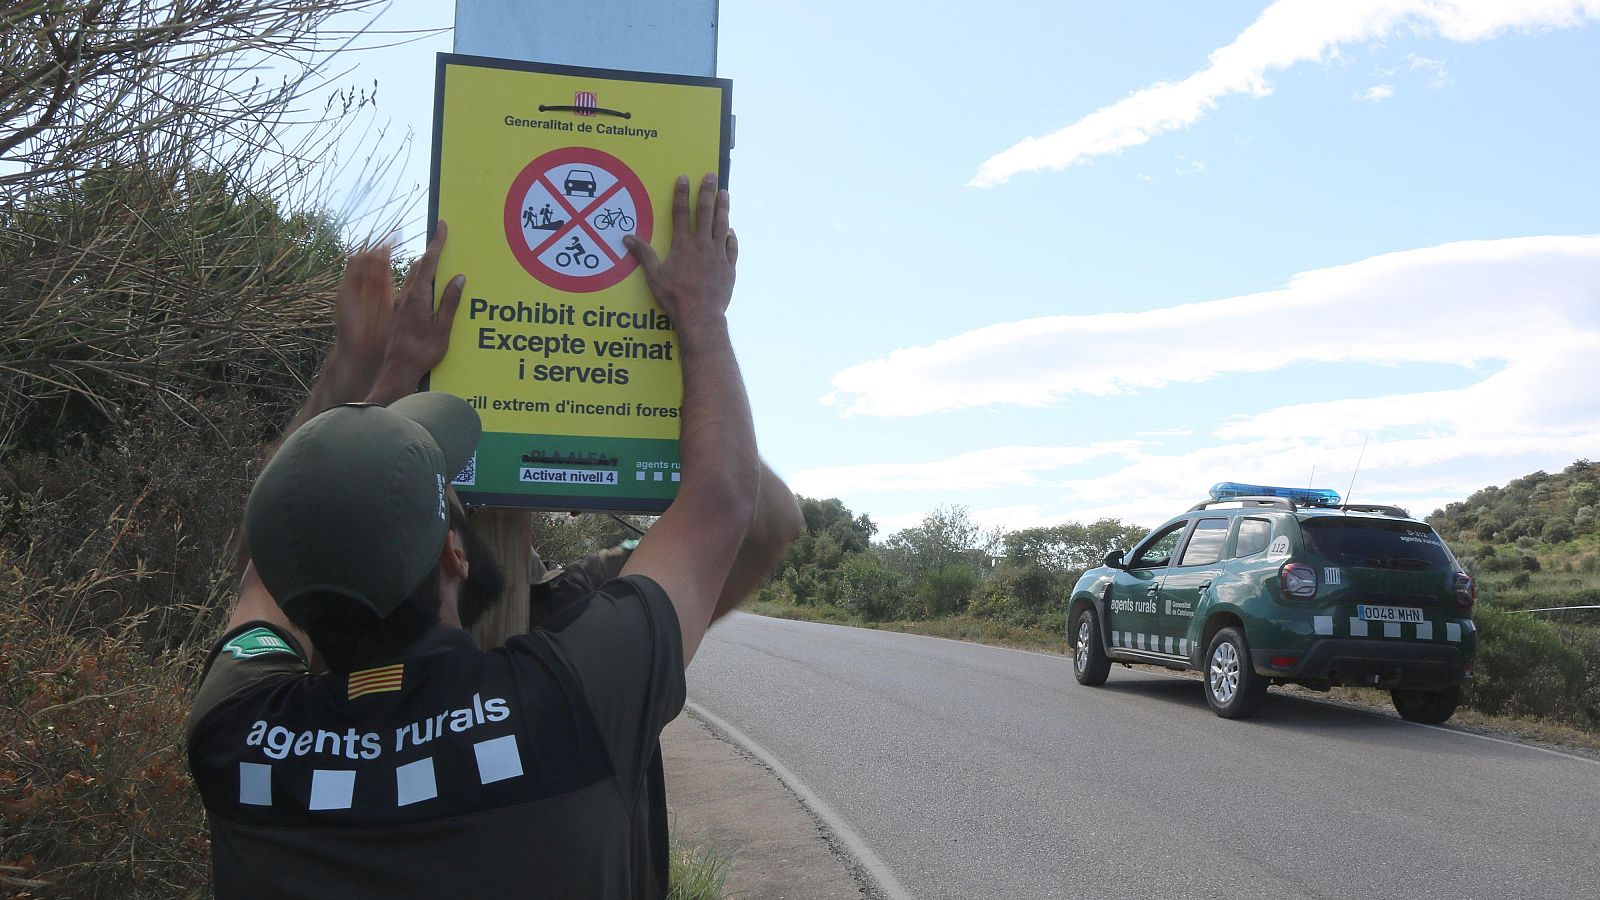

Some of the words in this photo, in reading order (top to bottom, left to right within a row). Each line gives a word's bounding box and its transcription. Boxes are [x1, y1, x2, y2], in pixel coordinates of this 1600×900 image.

[504, 115, 574, 132] Generalitat
[577, 121, 593, 133] de
[596, 123, 658, 139] Catalunya
[470, 298, 575, 326] Prohibit
[582, 306, 675, 331] circula
[478, 327, 586, 358] Excepte
[593, 337, 673, 361] veïnat
[518, 359, 525, 380] i
[533, 363, 629, 385] serveis
[466, 395, 487, 410] rill
[492, 398, 550, 412] extrem
[555, 398, 631, 416] d'incendi
[635, 460, 669, 470] agents
[522, 469, 567, 481] Activat
[570, 471, 603, 483] nivell
[606, 472, 614, 483] 4
[1271, 543, 1286, 553] 112
[1110, 598, 1134, 614] agents
[1135, 599, 1157, 614] rurals
[1365, 607, 1394, 620] 0048
[1398, 609, 1420, 622] MHN
[246, 720, 382, 760] agents
[395, 692, 511, 752] rurals
